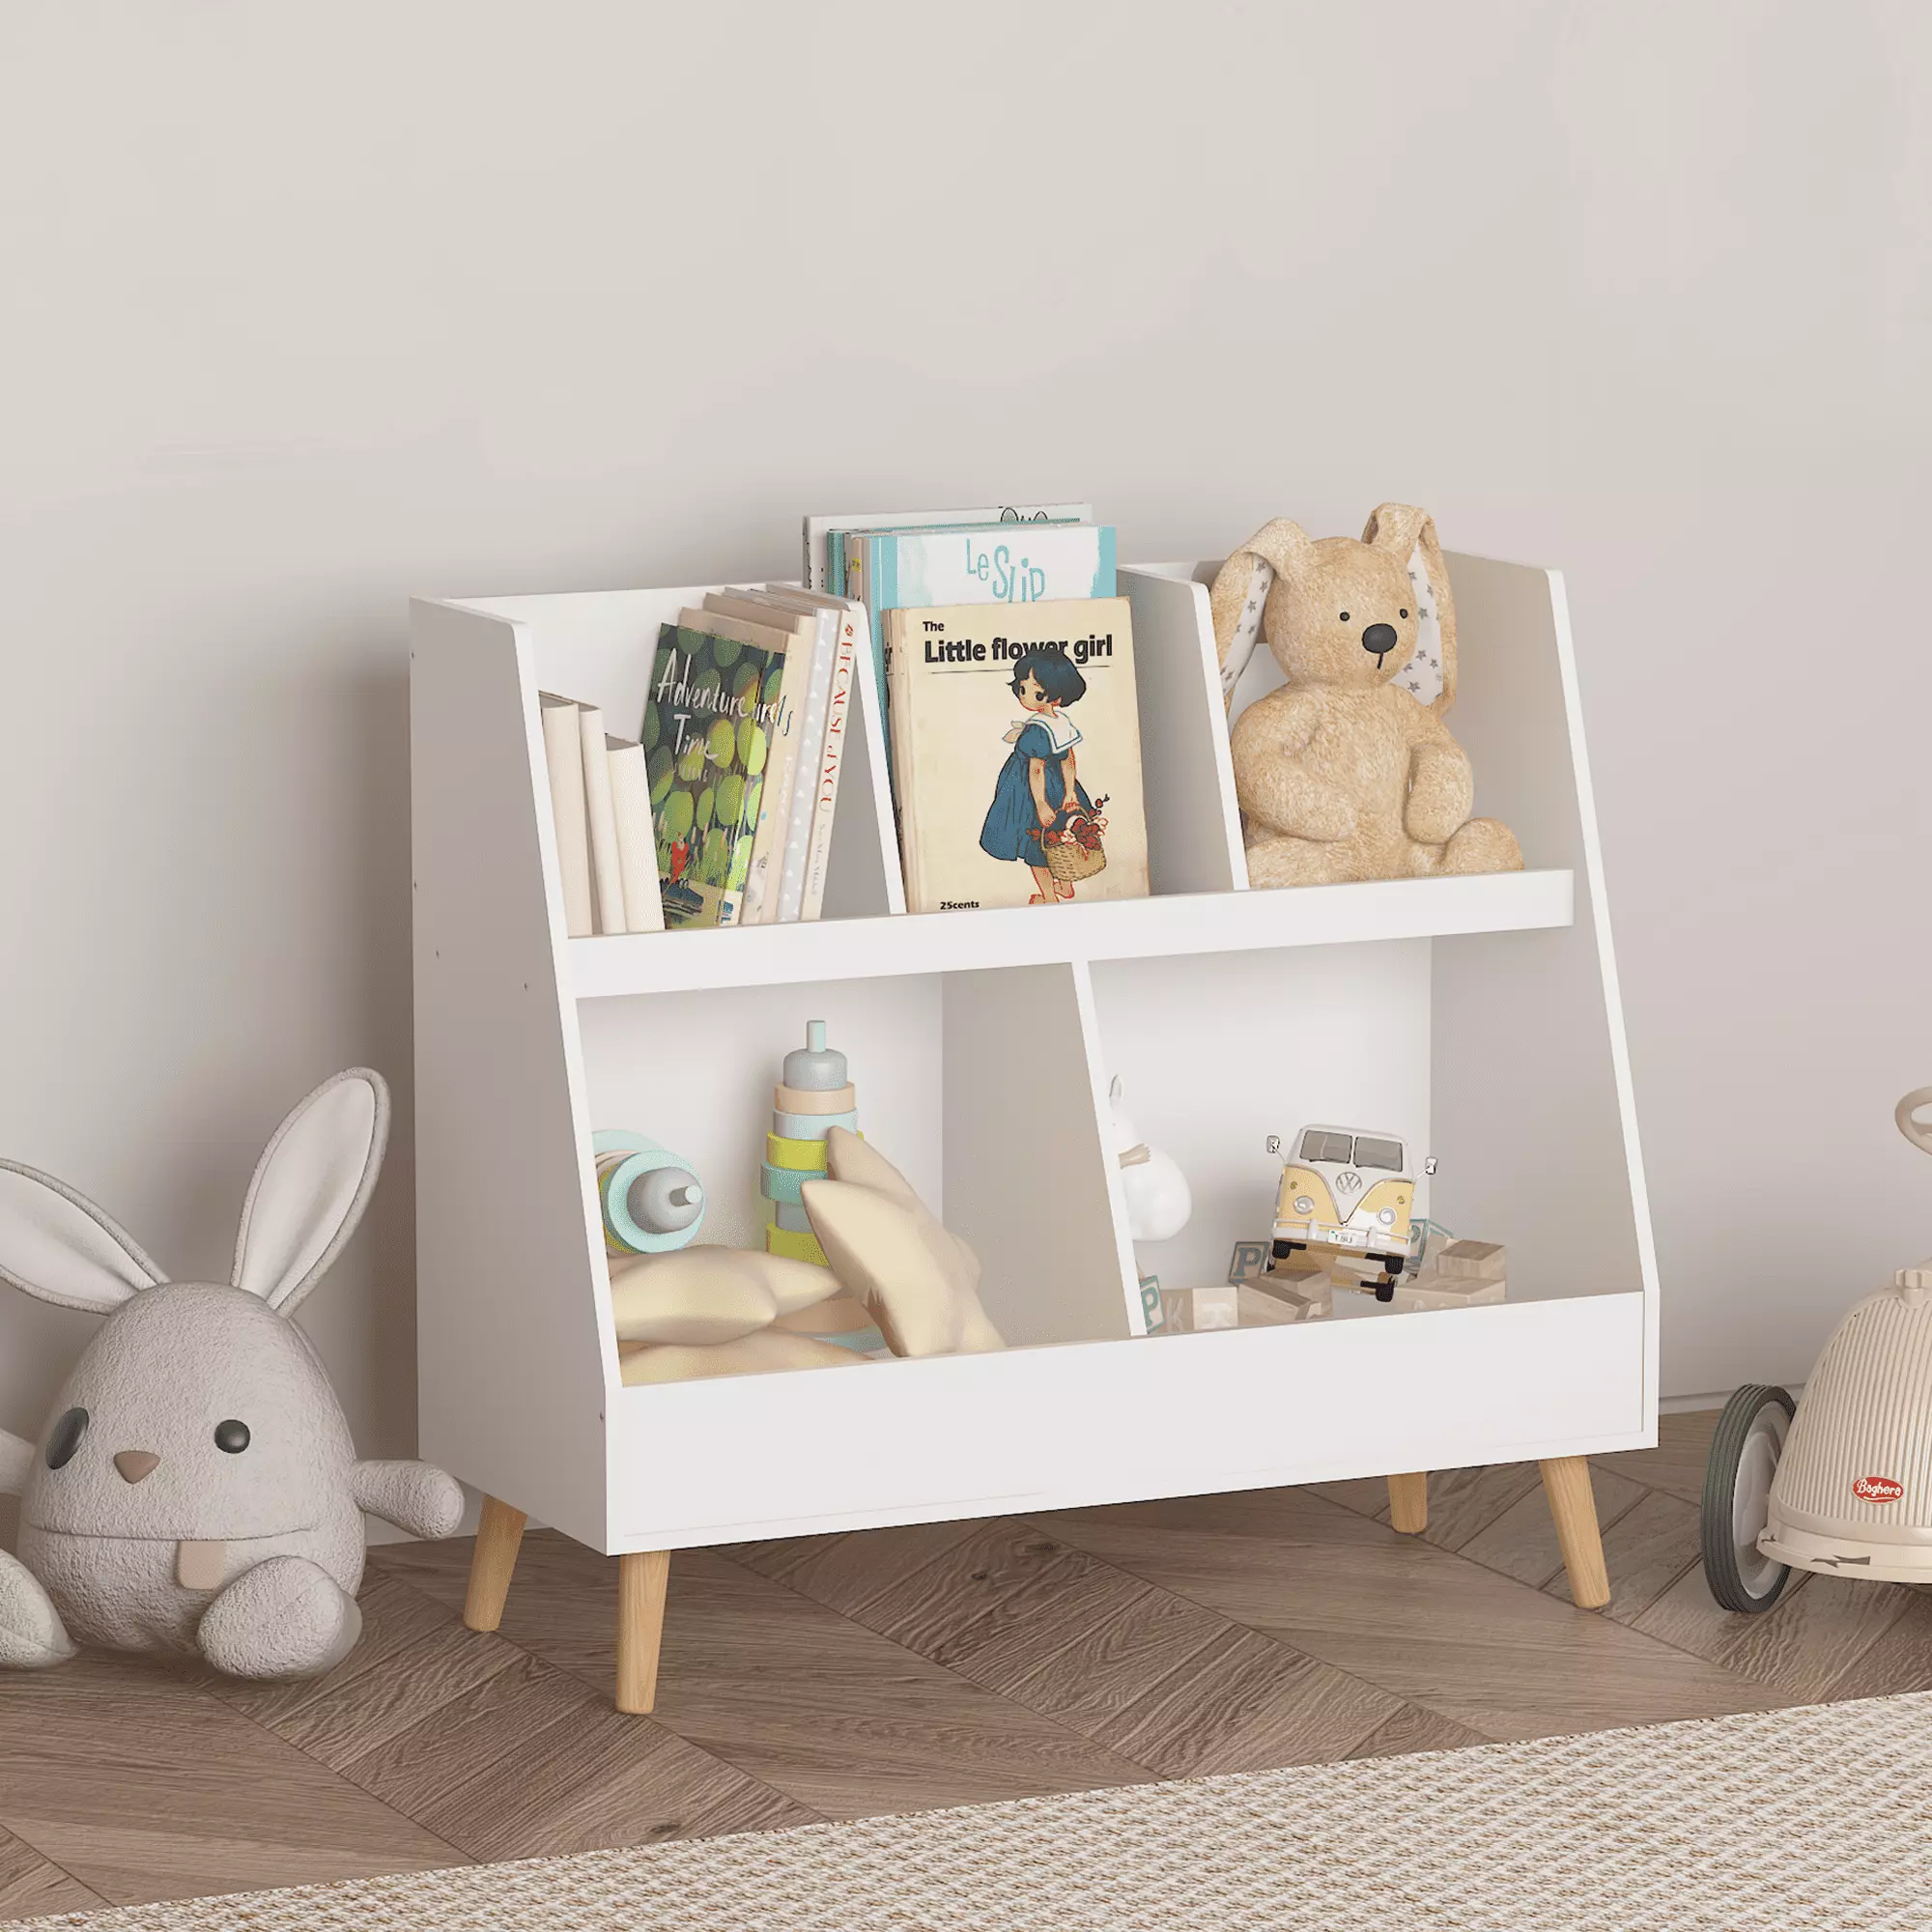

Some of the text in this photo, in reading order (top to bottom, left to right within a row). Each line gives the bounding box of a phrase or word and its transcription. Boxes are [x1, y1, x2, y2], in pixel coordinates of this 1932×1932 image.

[966, 538, 989, 581] Le
[923, 621, 945, 632] The
[924, 639, 986, 663] Little
[1073, 634, 1113, 664] girl
[657, 647, 749, 718] Adventure
[673, 713, 720, 760] Time
[819, 764, 837, 813] YOU
[940, 900, 980, 910] 25cents
[1857, 1479, 1901, 1496] Baghera
